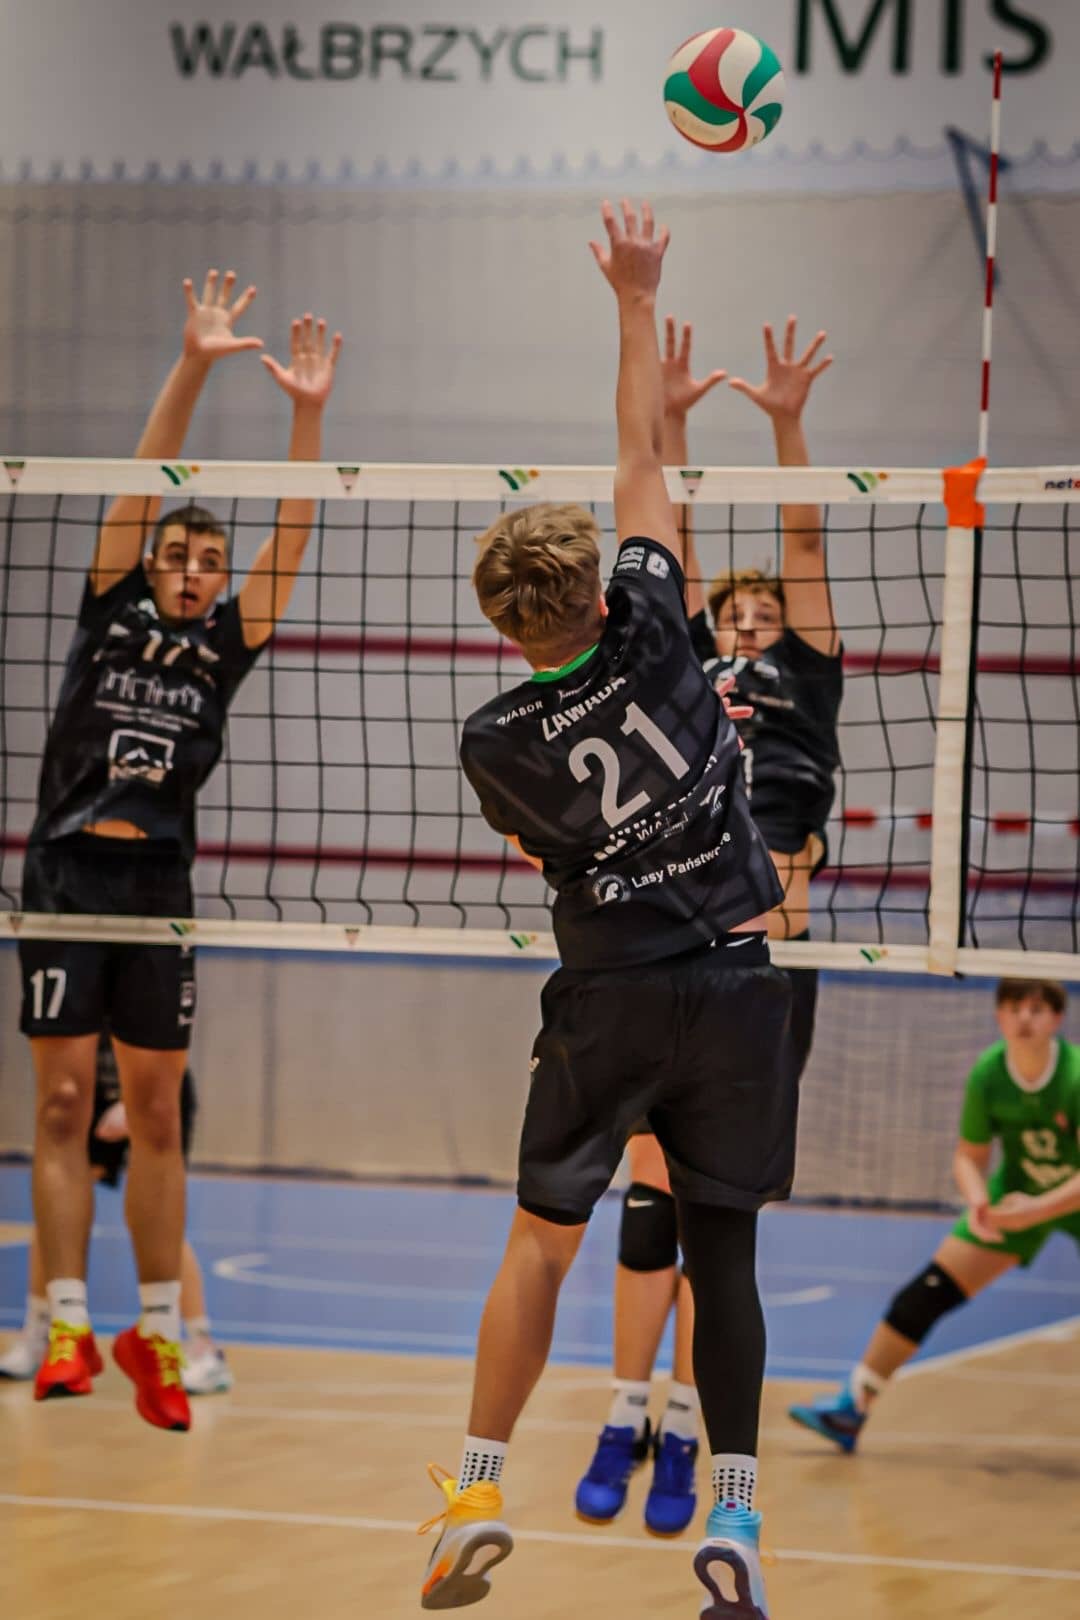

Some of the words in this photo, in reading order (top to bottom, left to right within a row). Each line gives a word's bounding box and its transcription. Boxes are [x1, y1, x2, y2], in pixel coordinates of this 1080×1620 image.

[169, 22, 604, 81] WAŁBRZYCH
[567, 701, 690, 829] 21
[631, 869, 664, 889] Lasy
[666, 831, 732, 877] Państwe
[30, 966, 67, 1020] 17
